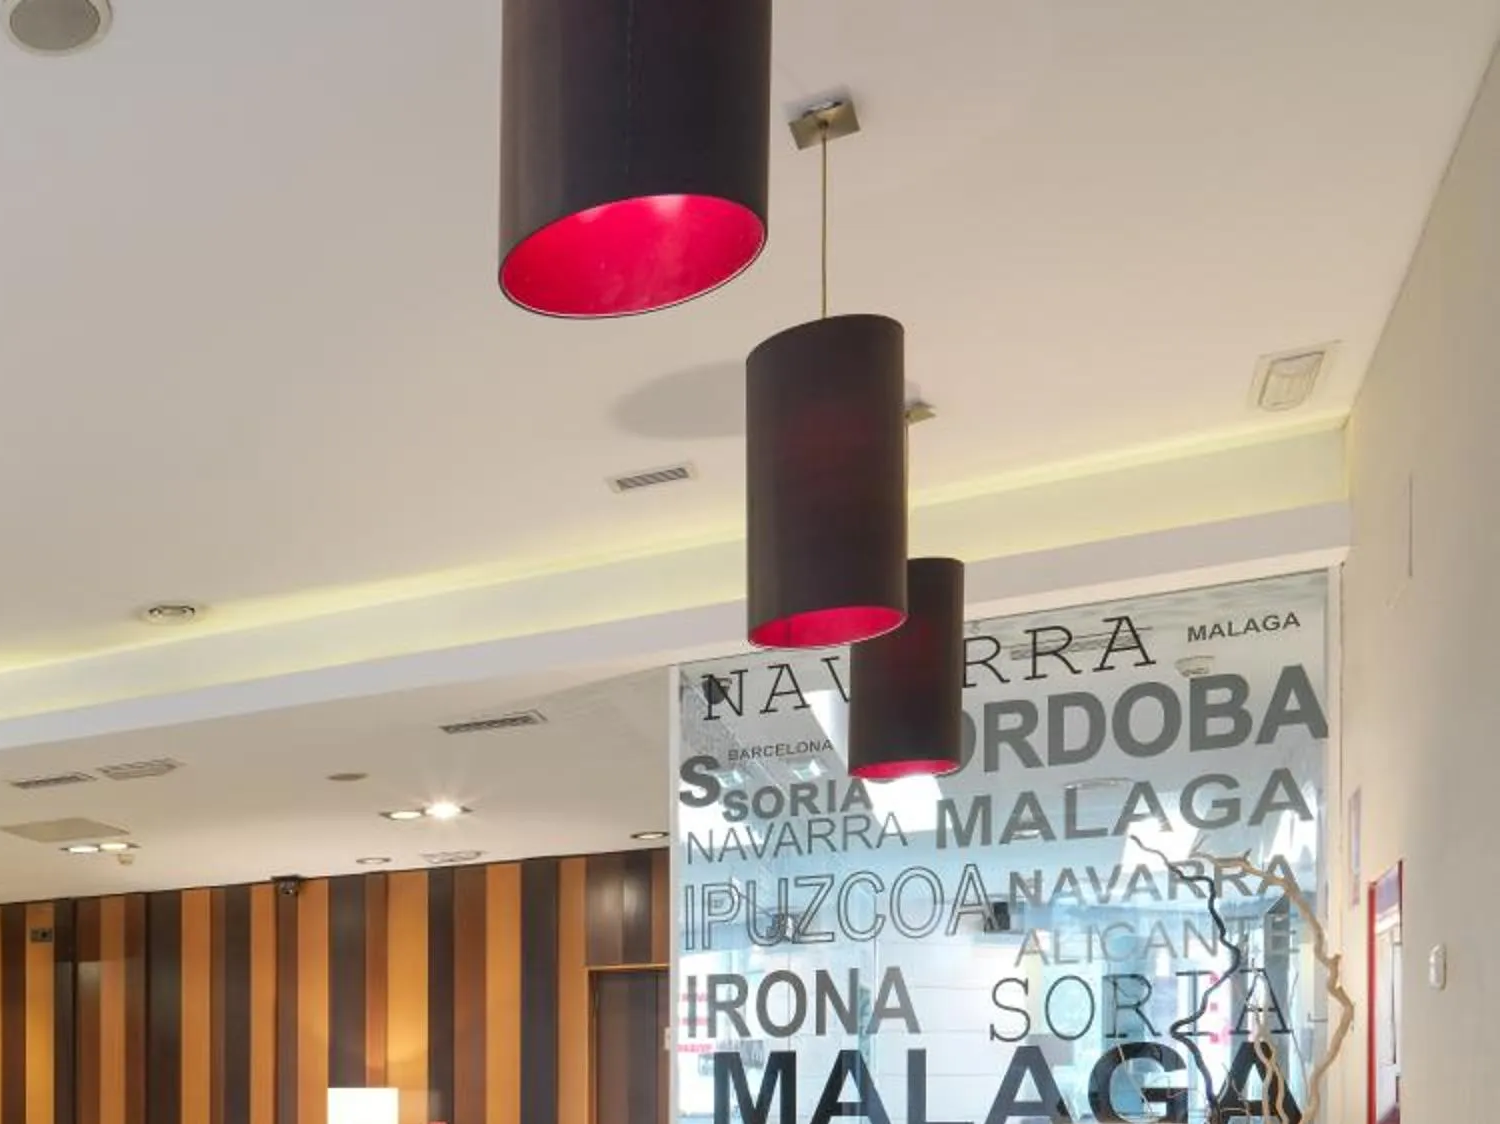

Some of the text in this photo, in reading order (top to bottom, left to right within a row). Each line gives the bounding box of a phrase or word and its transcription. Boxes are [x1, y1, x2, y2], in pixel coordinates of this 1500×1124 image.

[1187, 611, 1301, 643] MALAGA
[701, 616, 1157, 721] NAVRRA
[727, 739, 834, 762] BARCELONA
[937, 664, 1329, 778] RDOBA
[722, 779, 873, 822] SORIA
[935, 767, 1314, 849] MALAGA
[687, 811, 909, 865] NAVARRA
[684, 863, 998, 951] IPUZCOA
[1009, 854, 1298, 909] NAVARRA
[686, 966, 921, 1039] IRONA
[989, 967, 1294, 1042] SORIA
